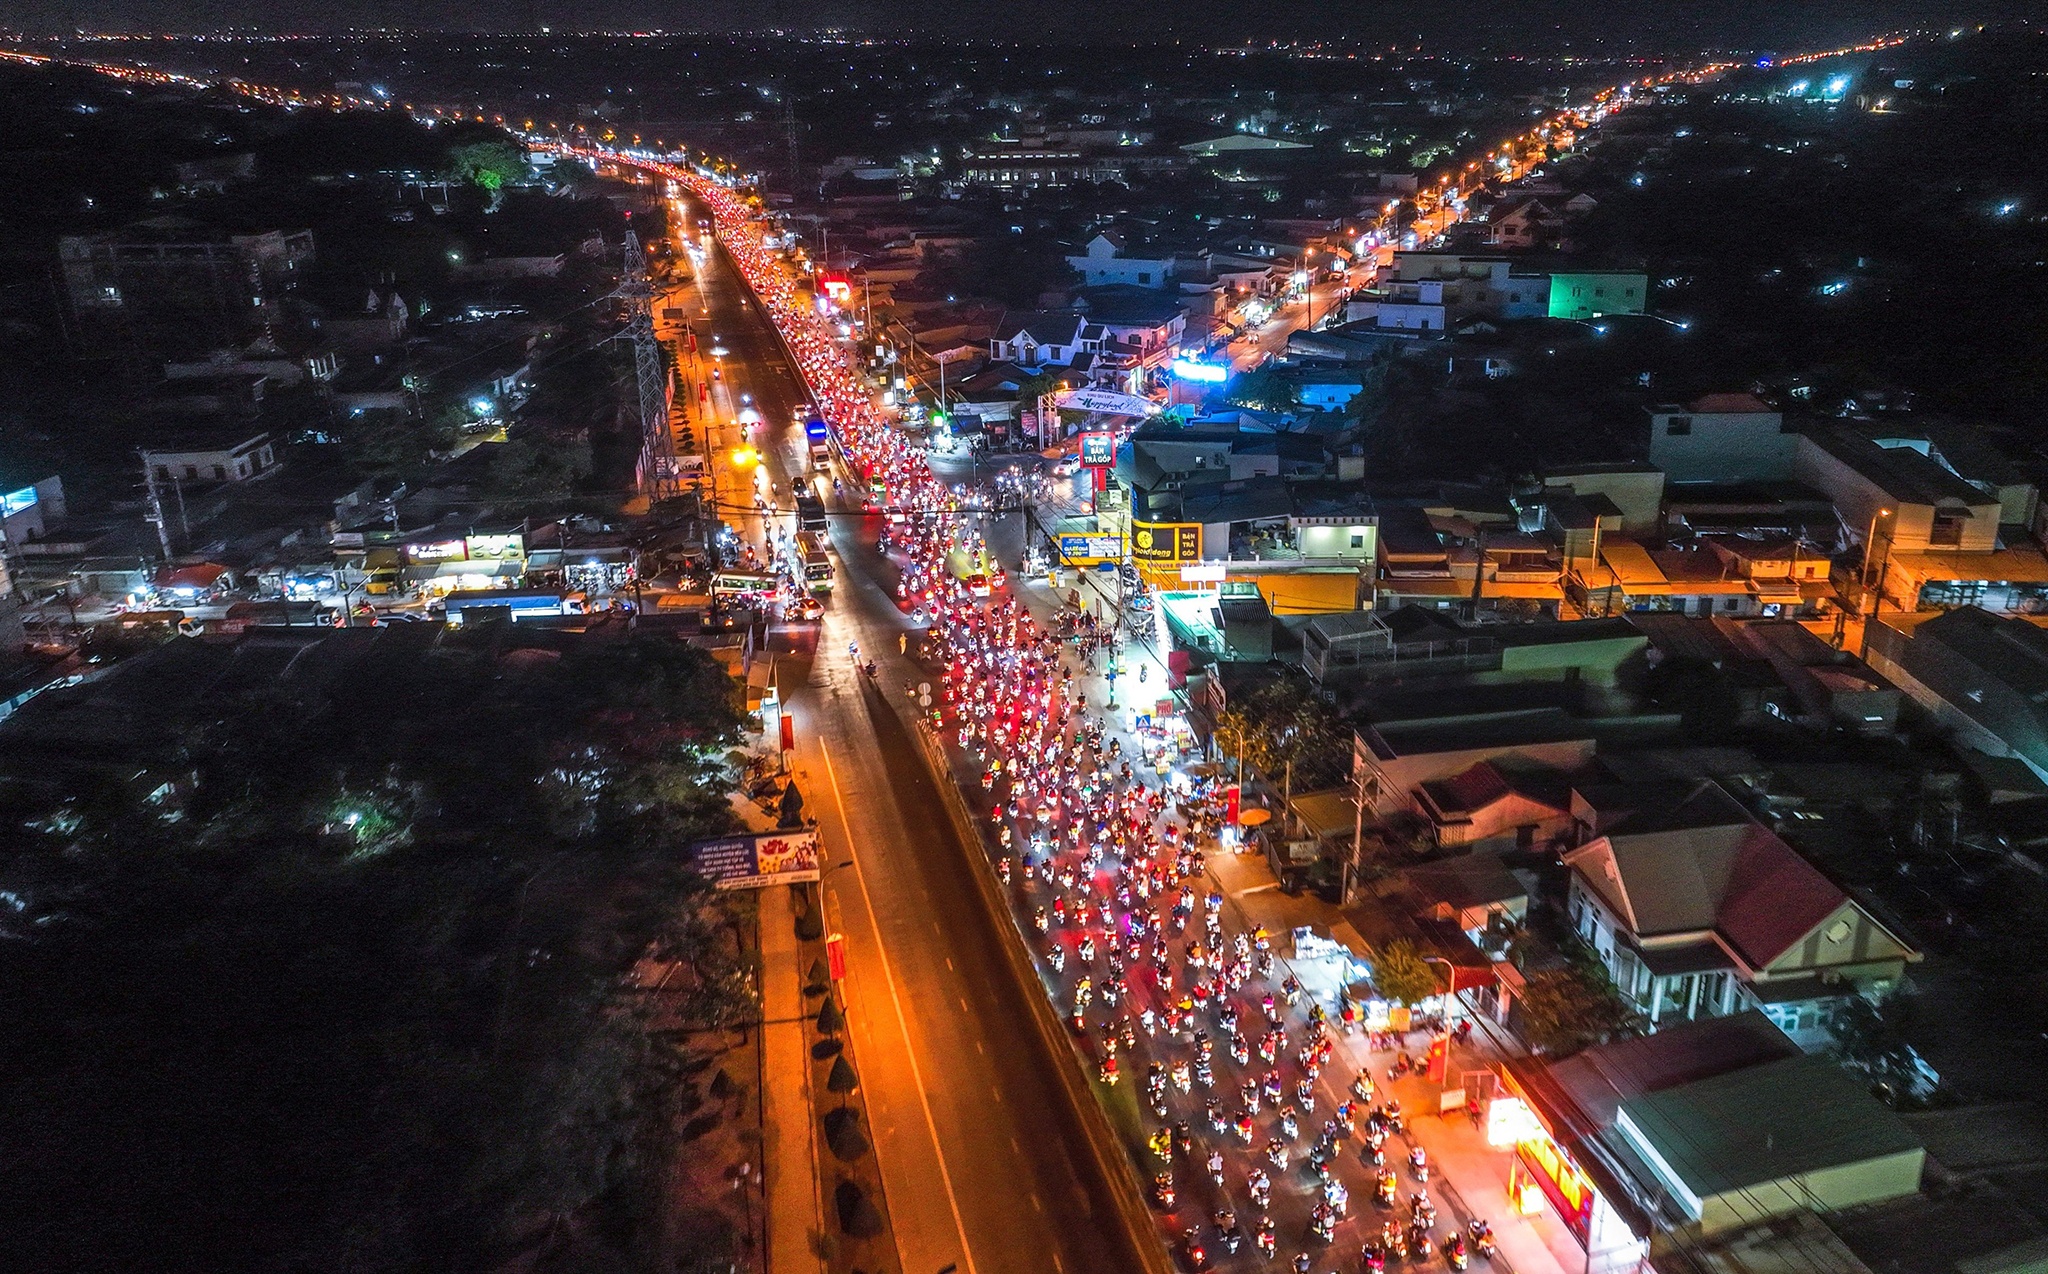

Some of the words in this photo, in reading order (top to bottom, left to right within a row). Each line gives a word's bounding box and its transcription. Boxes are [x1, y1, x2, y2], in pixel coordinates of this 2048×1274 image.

[1091, 446, 1104, 454] BÁN
[1084, 455, 1097, 463] TRẢ
[1098, 455, 1111, 463] GÓP
